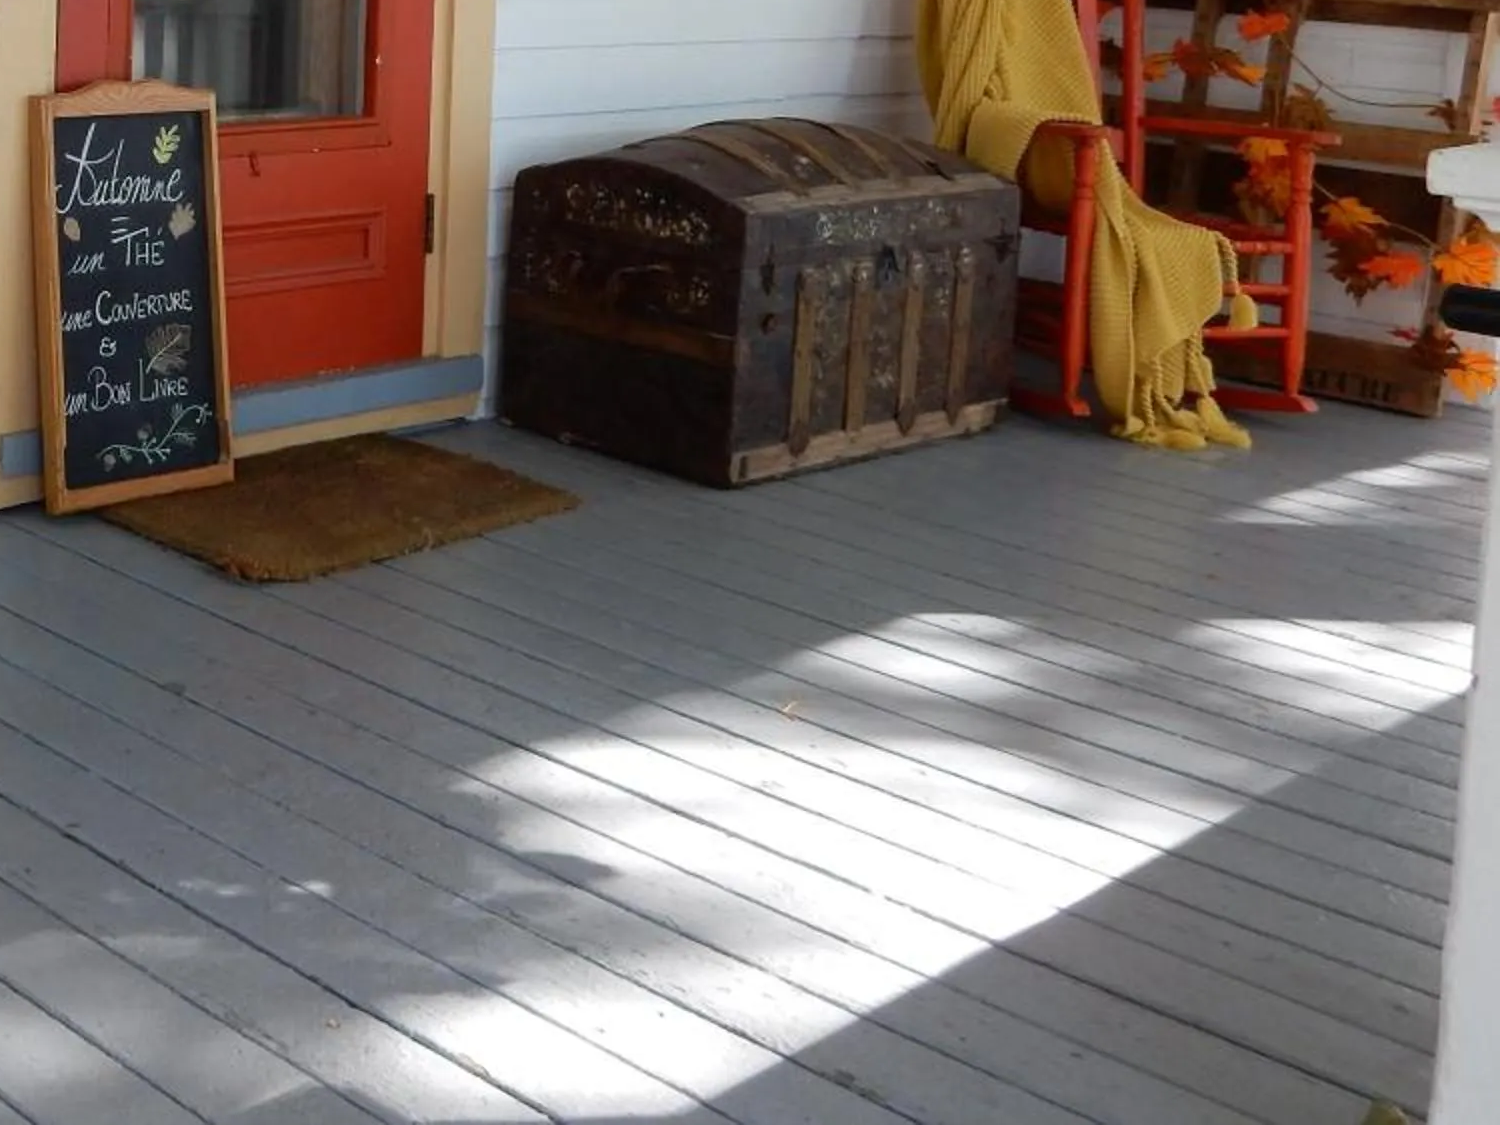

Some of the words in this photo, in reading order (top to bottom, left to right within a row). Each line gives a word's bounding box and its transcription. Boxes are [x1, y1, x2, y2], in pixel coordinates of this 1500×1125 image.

[54, 123, 183, 213] Automne
[67, 252, 106, 275] un
[60, 310, 93, 332] une
[100, 337, 117, 357] &
[64, 392, 88, 416] un
